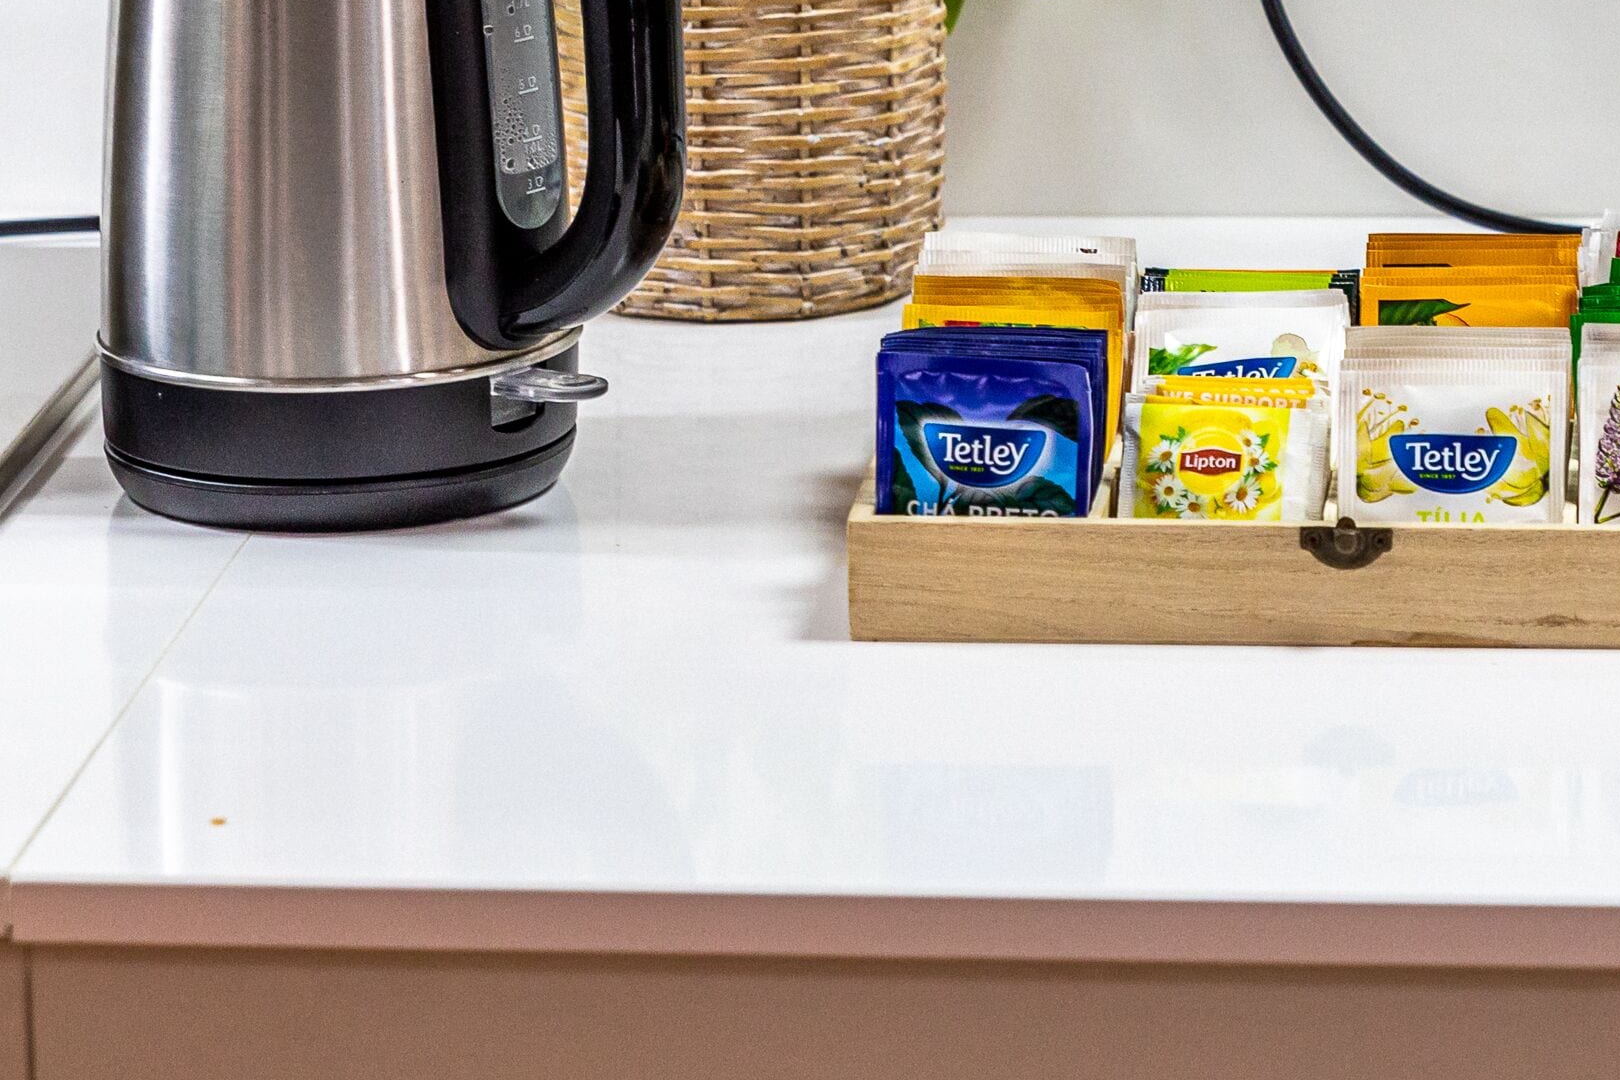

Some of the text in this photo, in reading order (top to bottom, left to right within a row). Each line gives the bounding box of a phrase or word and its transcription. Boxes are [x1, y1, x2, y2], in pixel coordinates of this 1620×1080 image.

[939, 432, 1030, 475] Tetley
[1185, 455, 1236, 470] Lipton
[1405, 442, 1500, 481] Tetley
